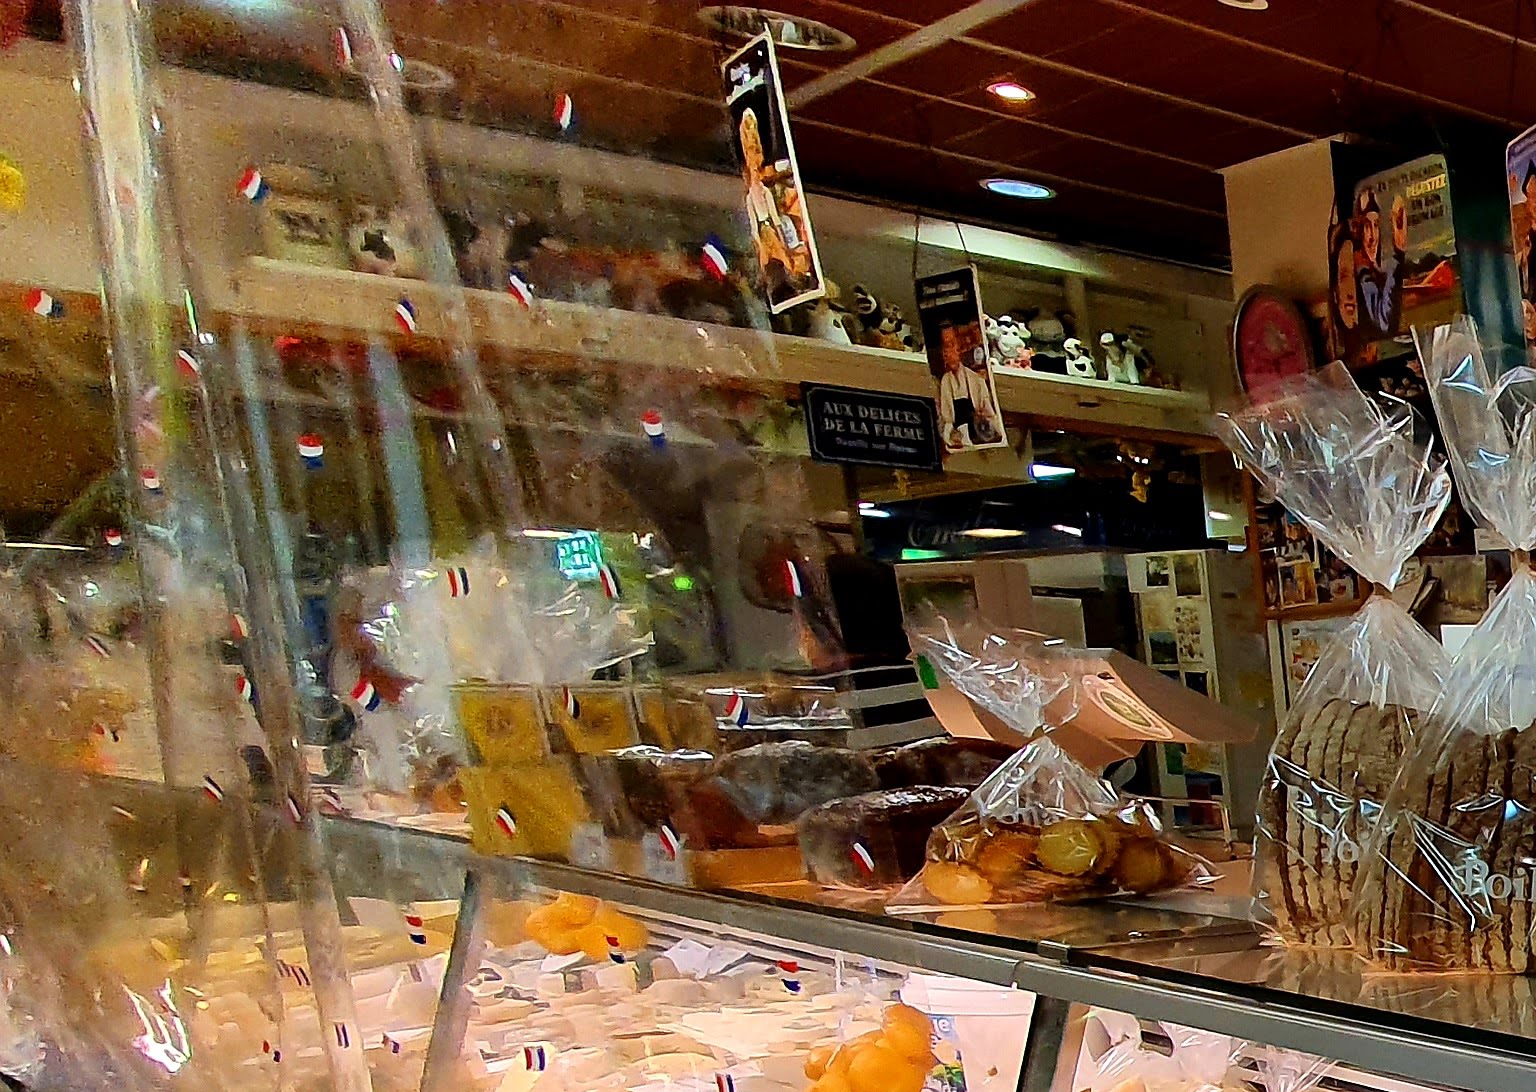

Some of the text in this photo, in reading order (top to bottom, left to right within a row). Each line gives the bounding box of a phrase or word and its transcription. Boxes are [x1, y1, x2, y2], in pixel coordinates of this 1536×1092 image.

[823, 401, 922, 424] AUX DELICES
[824, 418, 925, 441] DE LA FERME
